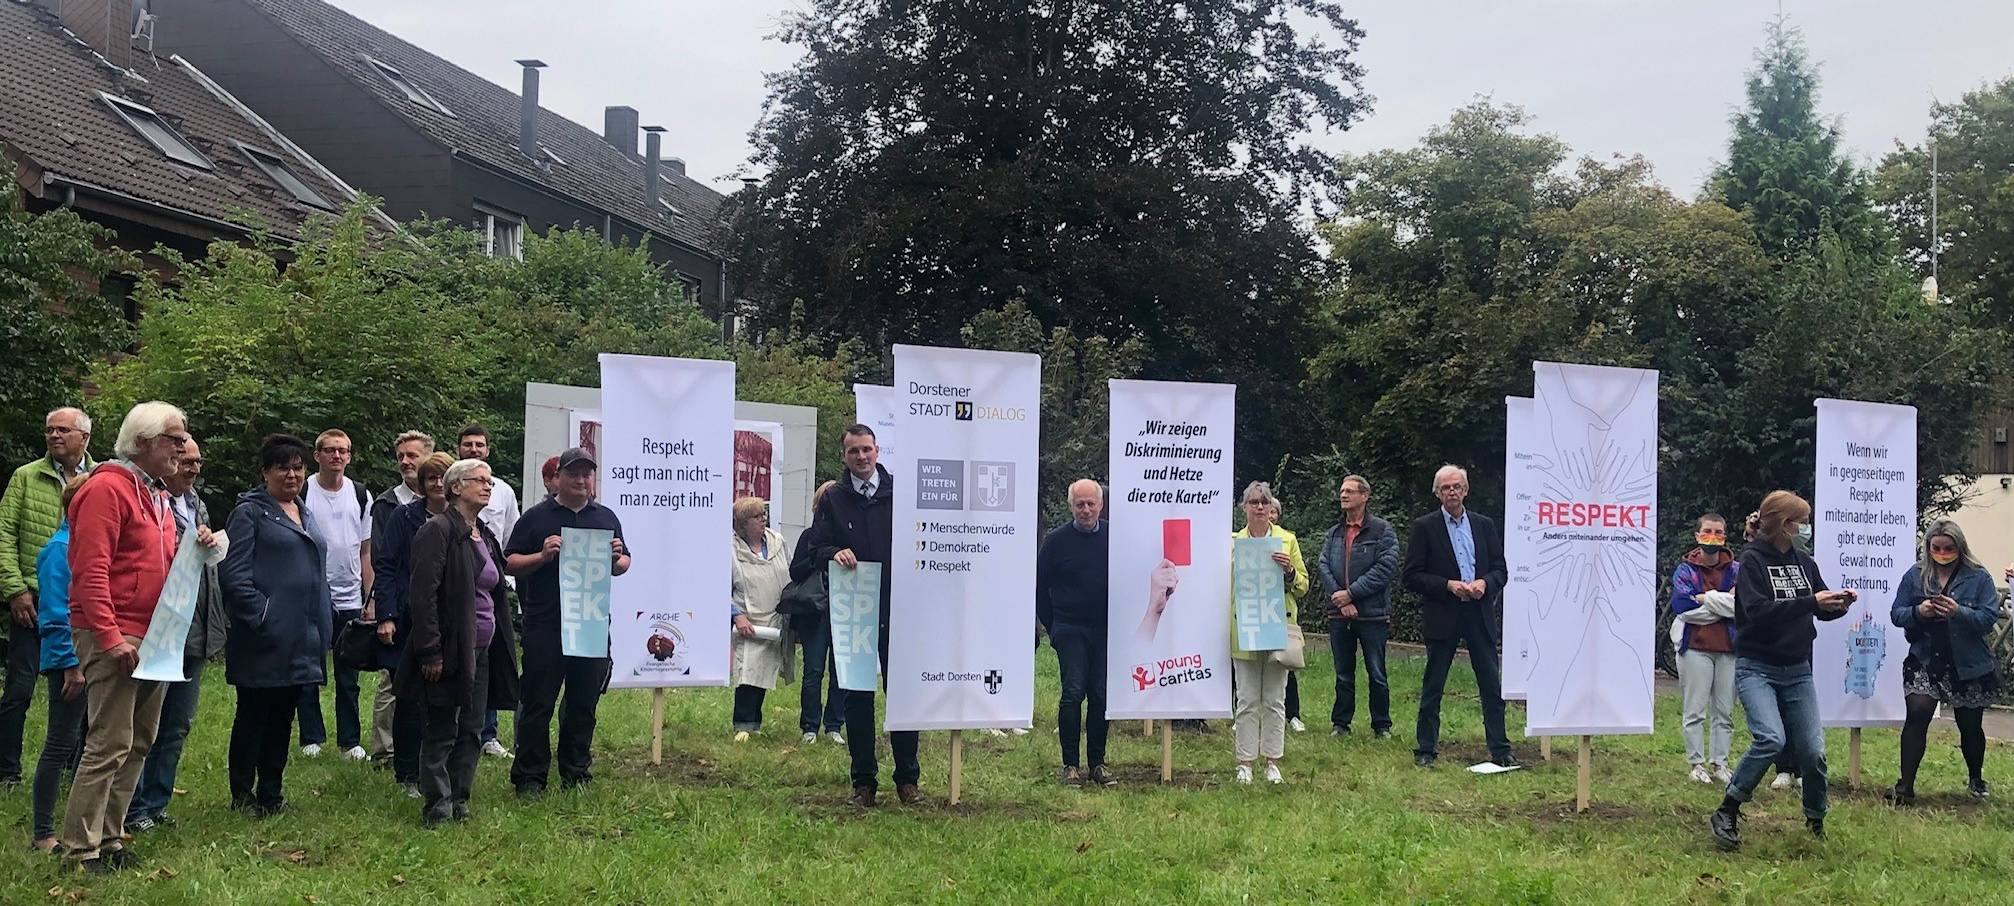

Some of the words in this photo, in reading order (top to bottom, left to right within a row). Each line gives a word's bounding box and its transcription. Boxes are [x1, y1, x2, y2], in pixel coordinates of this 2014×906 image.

[909, 381, 972, 398] Dorstener
[909, 402, 952, 417] STADT
[976, 406, 1026, 421] DIALOG
[1138, 420, 1168, 436] „Wir
[1168, 421, 1207, 440] zeigen
[642, 437, 695, 459] Respekt
[1124, 442, 1222, 463] Diskriminierung
[1846, 442, 1871, 458] Wenn
[1873, 445, 1889, 459] wir
[611, 465, 640, 484] sagt
[643, 467, 673, 481] man
[677, 465, 709, 482] nicht
[921, 465, 942, 474] WIR
[1143, 465, 1168, 480] und
[1169, 466, 1203, 481] Hetze
[1829, 463, 1839, 477] in
[1840, 465, 1905, 485] gegenseitigem
[921, 478, 956, 488] TRETEN
[619, 493, 650, 507] man
[652, 491, 686, 512] zeigt
[688, 491, 714, 508] ihn!
[921, 491, 938, 501] EIN
[940, 491, 958, 502] FÜR
[1127, 487, 1147, 503] die
[1148, 490, 1173, 504] rote
[1849, 486, 1884, 505] Respekt
[1538, 501, 1651, 528] RESPEKT
[1825, 508, 1879, 525] miteinander
[1880, 509, 1909, 527] leben,
[929, 521, 1015, 536] Menschenwürde
[1542, 531, 1568, 541] Anders
[1568, 533, 1609, 542] miteinander
[1610, 534, 1646, 544] umgehen.
[929, 540, 991, 554] Demokratie
[1837, 530, 1855, 549] gibt
[1857, 534, 1866, 546] es
[1866, 532, 1897, 547] weder
[929, 559, 972, 574] Respekt
[1839, 552, 1868, 568] Gewalt
[1870, 554, 1894, 569] noch
[563, 560, 607, 590] SP
[1240, 571, 1278, 598] SP
[1841, 573, 1892, 595] Zerstörung.
[563, 591, 608, 622] EK
[832, 592, 874, 623] SP
[1241, 598, 1282, 625] EK
[649, 613, 680, 622] ARCHE
[564, 622, 581, 651] T
[834, 623, 874, 655] EK
[1158, 654, 1202, 676] young
[921, 671, 945, 682] Stadt
[947, 671, 982, 682] Dorsten
[1159, 668, 1212, 687] caritas
